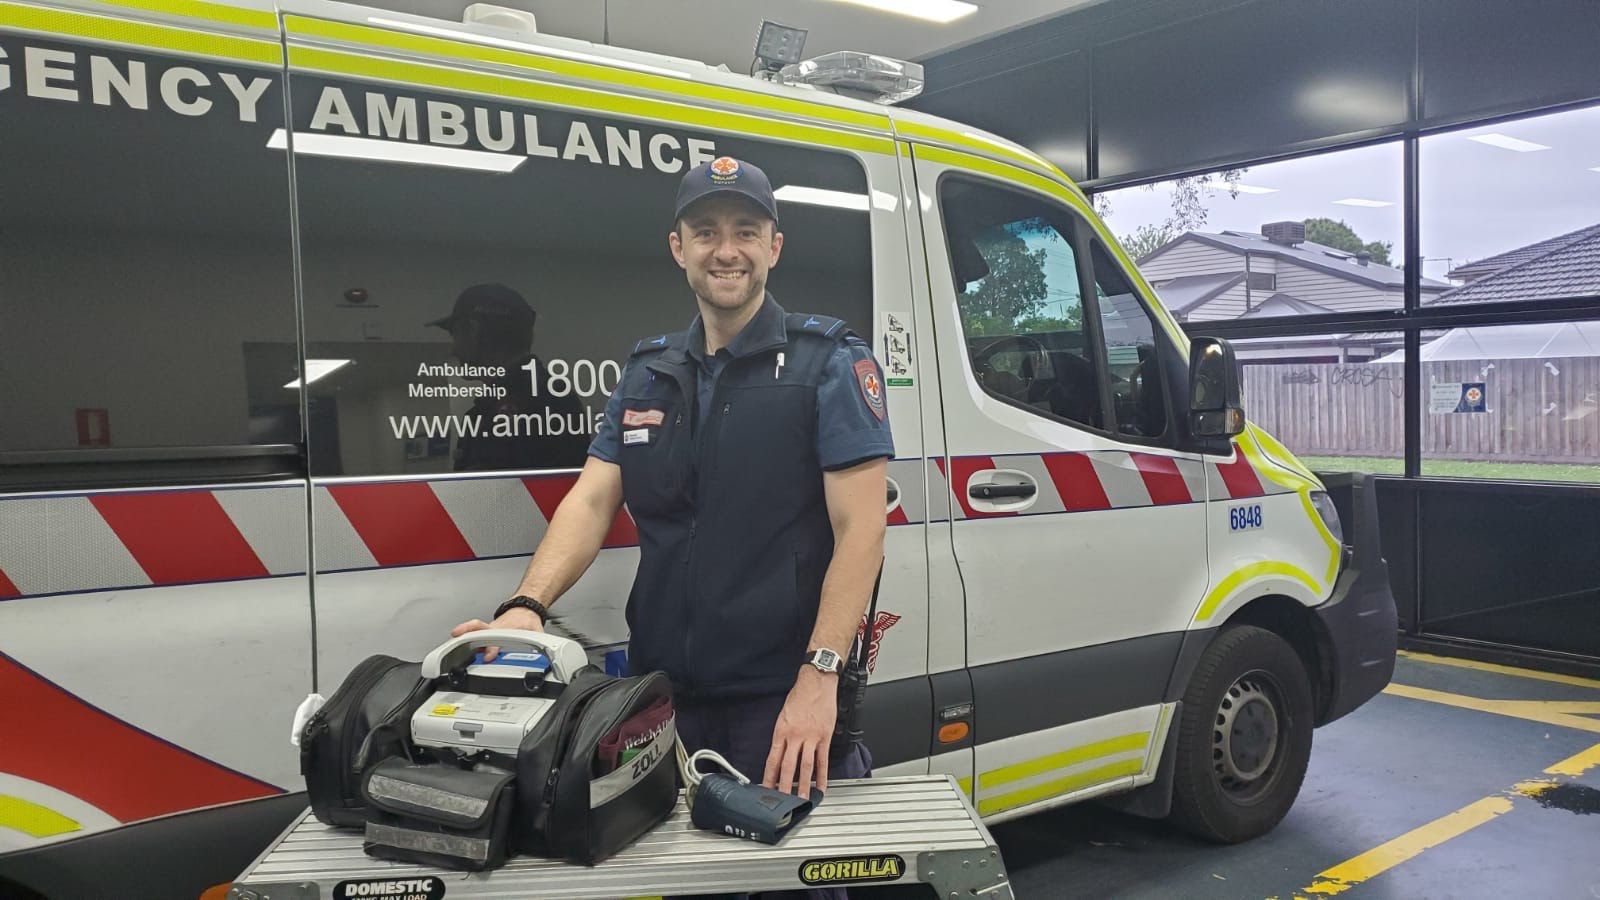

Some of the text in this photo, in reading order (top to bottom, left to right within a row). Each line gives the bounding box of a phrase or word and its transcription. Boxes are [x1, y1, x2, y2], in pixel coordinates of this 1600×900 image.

[0, 45, 273, 122] ENCY
[417, 362, 506, 377] Ambulance
[520, 358, 621, 397] 1800
[408, 383, 507, 400] Membership
[1230, 505, 1262, 530] 6848
[632, 743, 662, 780] ZOLL
[804, 858, 900, 881] GORILLA
[345, 879, 433, 896] DOMESTIC
